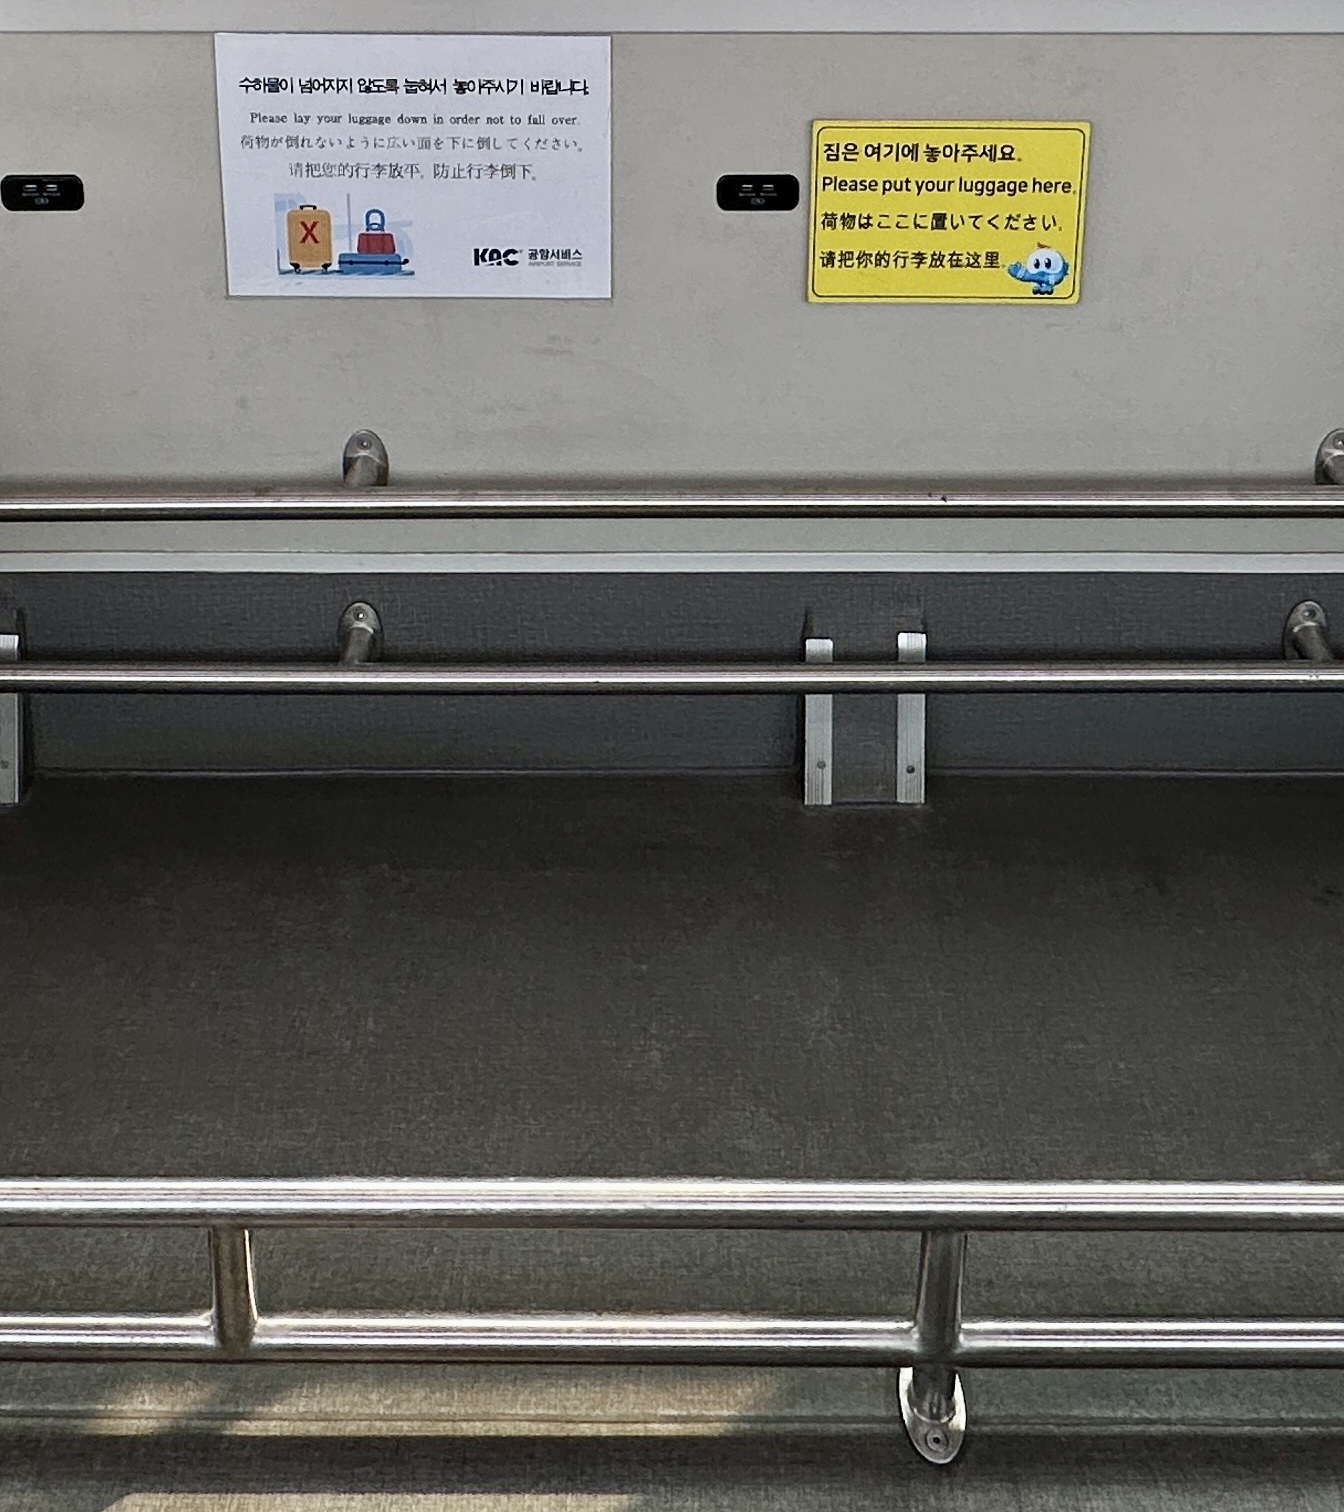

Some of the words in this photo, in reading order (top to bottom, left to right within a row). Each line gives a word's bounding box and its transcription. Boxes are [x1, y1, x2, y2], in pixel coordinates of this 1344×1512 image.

[238, 76, 294, 94] 수하물이
[298, 77, 353, 94] 넘어지지
[357, 78, 400, 95] 않도록
[250, 112, 288, 124] Please
[294, 113, 311, 126] lay
[317, 116, 343, 127] your
[348, 113, 392, 127] luggage
[397, 114, 428, 125] down
[433, 114, 444, 125] in
[449, 114, 480, 125] order
[486, 115, 505, 126] not
[510, 116, 522, 126] to
[527, 114, 546, 126] fall
[823, 143, 860, 162] 짐은
[864, 143, 920, 163] 여기에
[922, 143, 1022, 164] 놓아주세요.
[822, 176, 879, 193] Please
[882, 178, 912, 196] put
[914, 180, 956, 197] your
[958, 176, 1029, 197] luggage
[1033, 177, 1077, 196] here.
[473, 248, 520, 266] KAC
